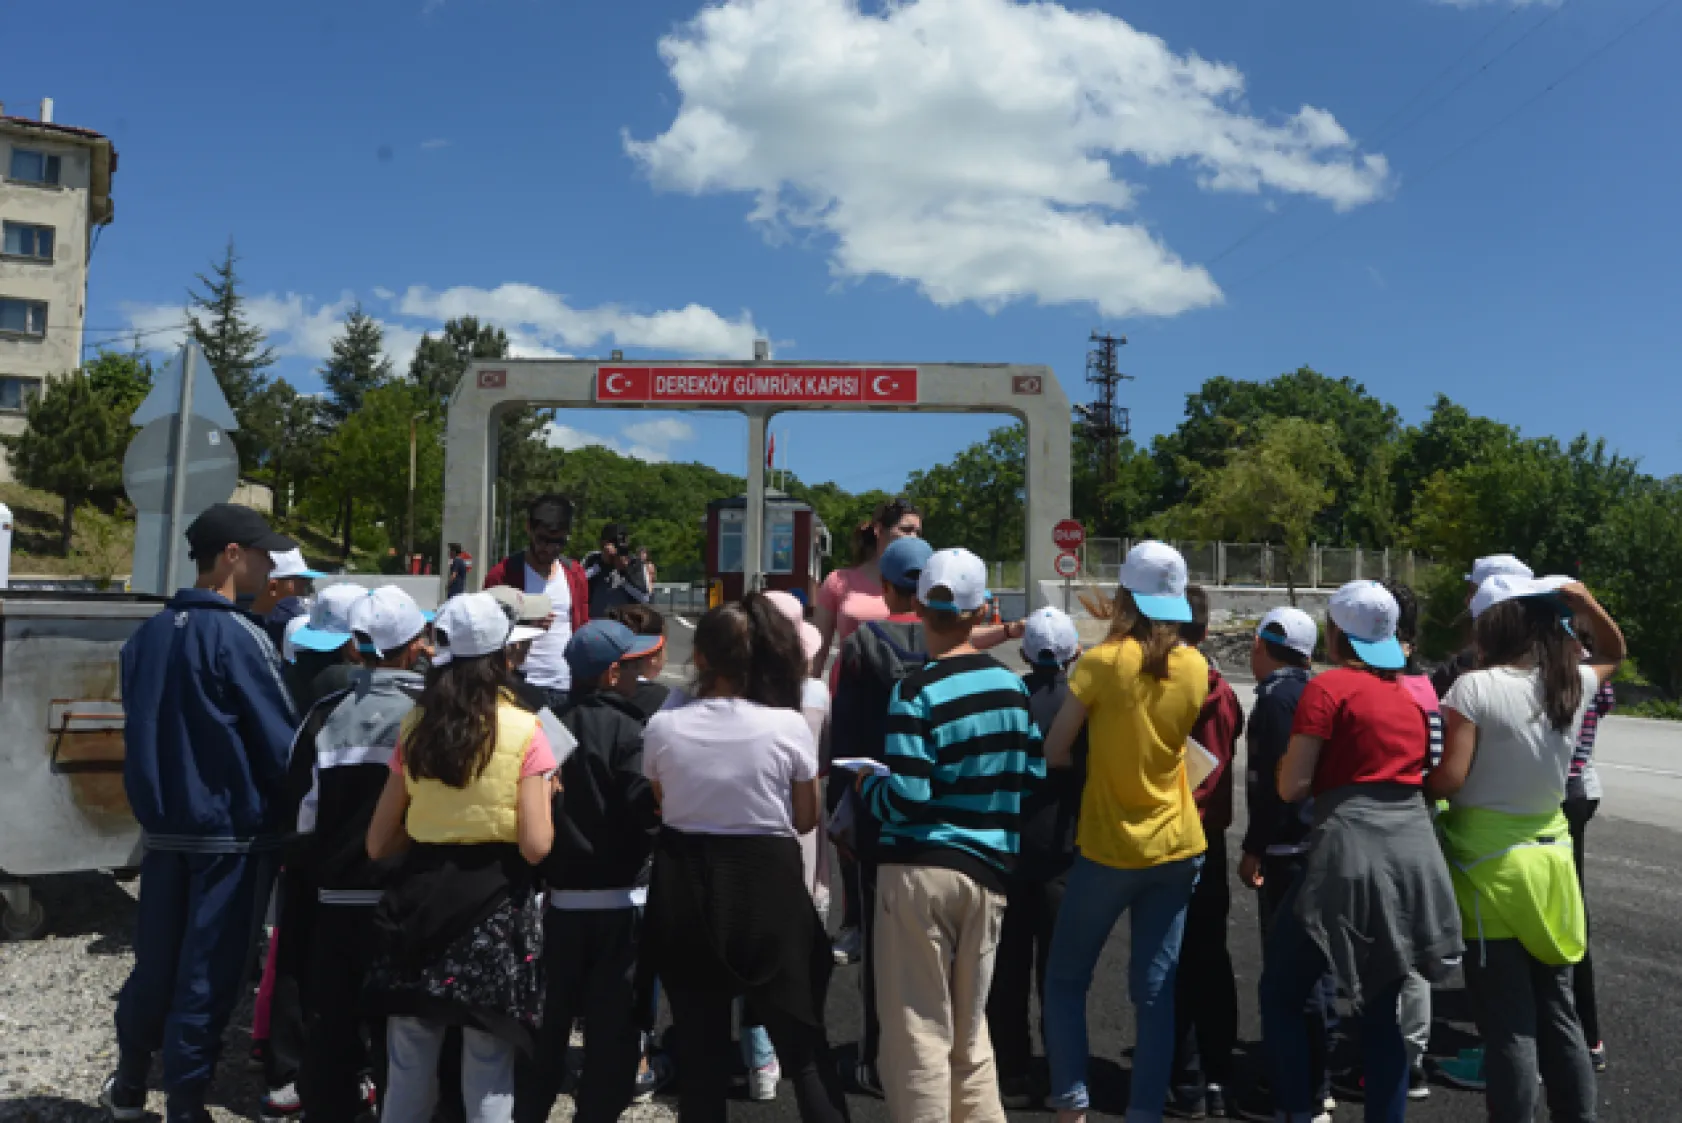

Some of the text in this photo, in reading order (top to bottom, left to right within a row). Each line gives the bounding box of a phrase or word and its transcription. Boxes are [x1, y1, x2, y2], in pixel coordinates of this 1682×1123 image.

[656, 372, 859, 395] DEREKÖY GÜMRÜK KAPISI
